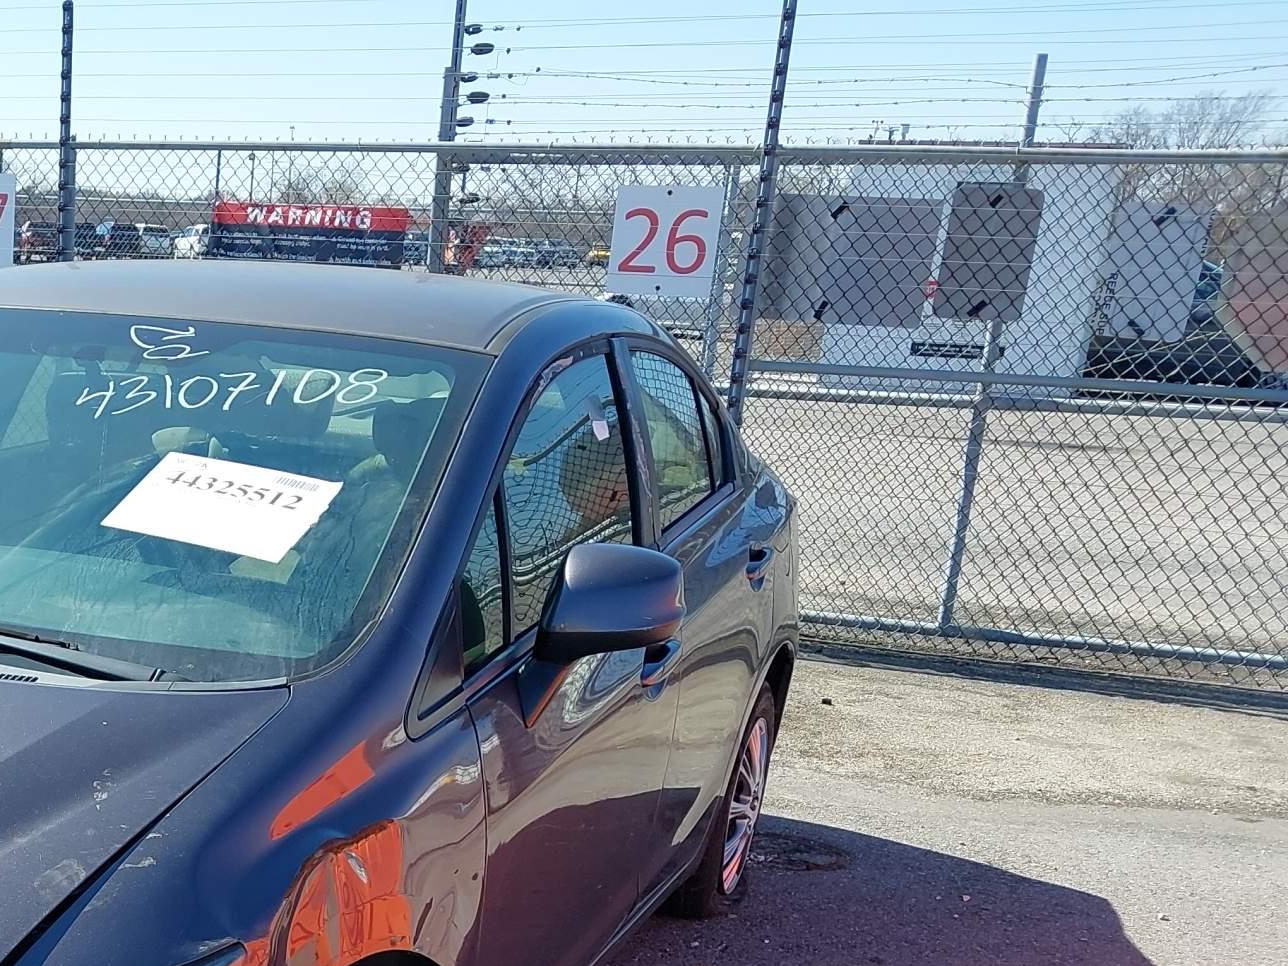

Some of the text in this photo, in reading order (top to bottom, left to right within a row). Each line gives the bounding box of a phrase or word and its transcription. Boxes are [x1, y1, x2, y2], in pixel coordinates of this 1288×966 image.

[247, 206, 372, 229] WARNING
[618, 208, 709, 275] 26
[76, 369, 388, 420] 43107108
[166, 470, 303, 510] 44325512
